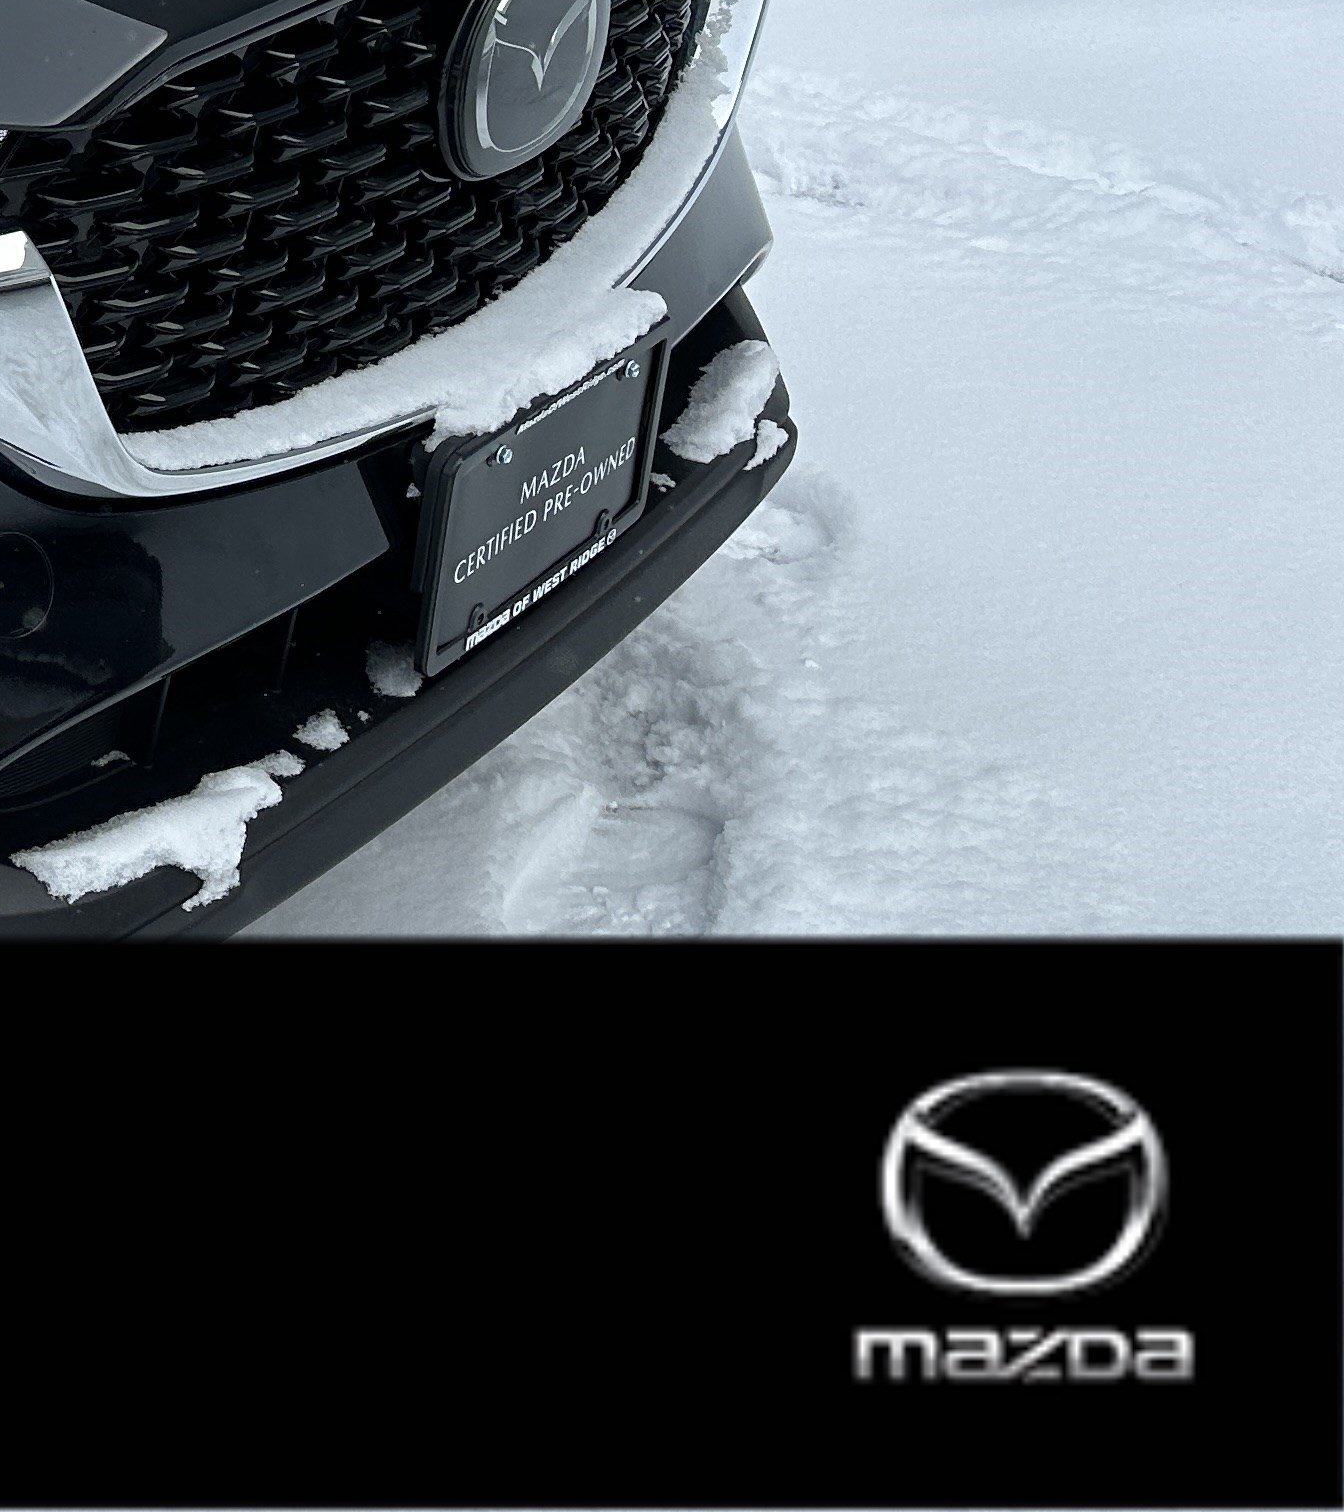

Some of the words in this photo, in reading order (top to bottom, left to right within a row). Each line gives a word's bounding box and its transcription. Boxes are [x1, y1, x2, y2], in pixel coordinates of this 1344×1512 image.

[454, 509, 538, 584] CERTIFIED
[543, 437, 636, 522] PRE-OWNED
[520, 446, 586, 504] MAZDA
[512, 594, 531, 617] OF
[533, 566, 568, 603] WEST
[569, 536, 605, 576] RIDGE
